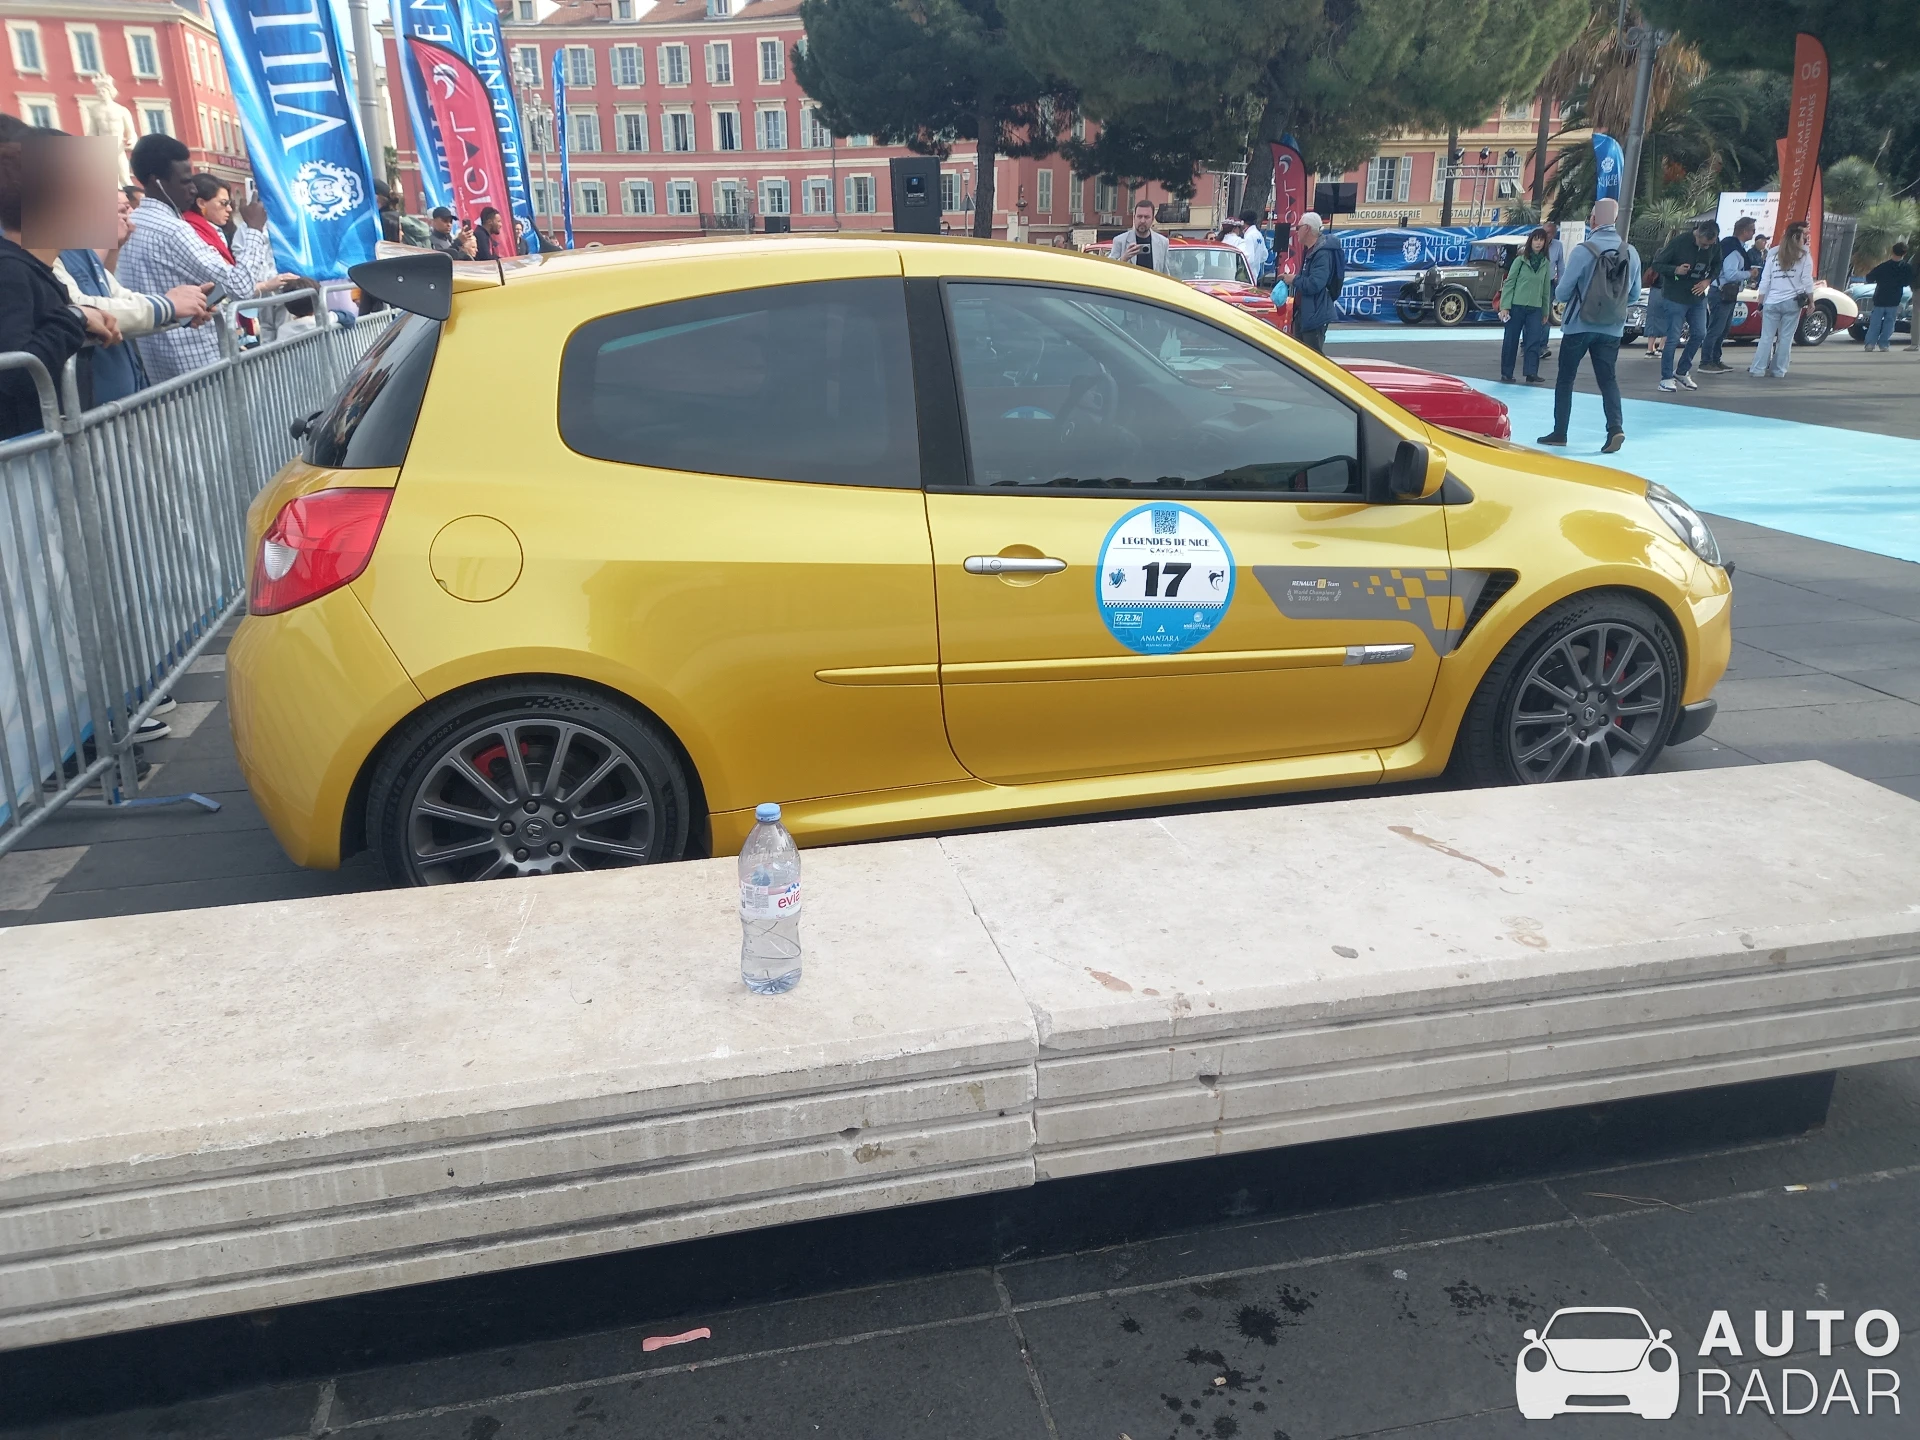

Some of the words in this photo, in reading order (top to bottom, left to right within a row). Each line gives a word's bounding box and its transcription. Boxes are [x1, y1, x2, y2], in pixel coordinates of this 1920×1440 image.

[469, 20, 505, 92] NICE
[1801, 60, 1822, 81] 06
[497, 97, 513, 134] DE
[503, 141, 527, 208] VILLE
[1598, 179, 1618, 188] NICE
[1340, 238, 1360, 248] ILLE
[1362, 238, 1377, 247] DE
[1424, 237, 1456, 247] VILLE
[1345, 248, 1375, 265] ICE
[1423, 245, 1467, 263] NICE
[1340, 286, 1363, 297] ILLE
[1367, 286, 1383, 297] DE
[1334, 297, 1383, 316] NICE
[1122, 537, 1172, 546] LEGENDES
[1174, 538, 1187, 546] DE
[1189, 539, 1210, 547] NICE
[1142, 562, 1192, 598] 17
[427, 724, 453, 746] SPORT
